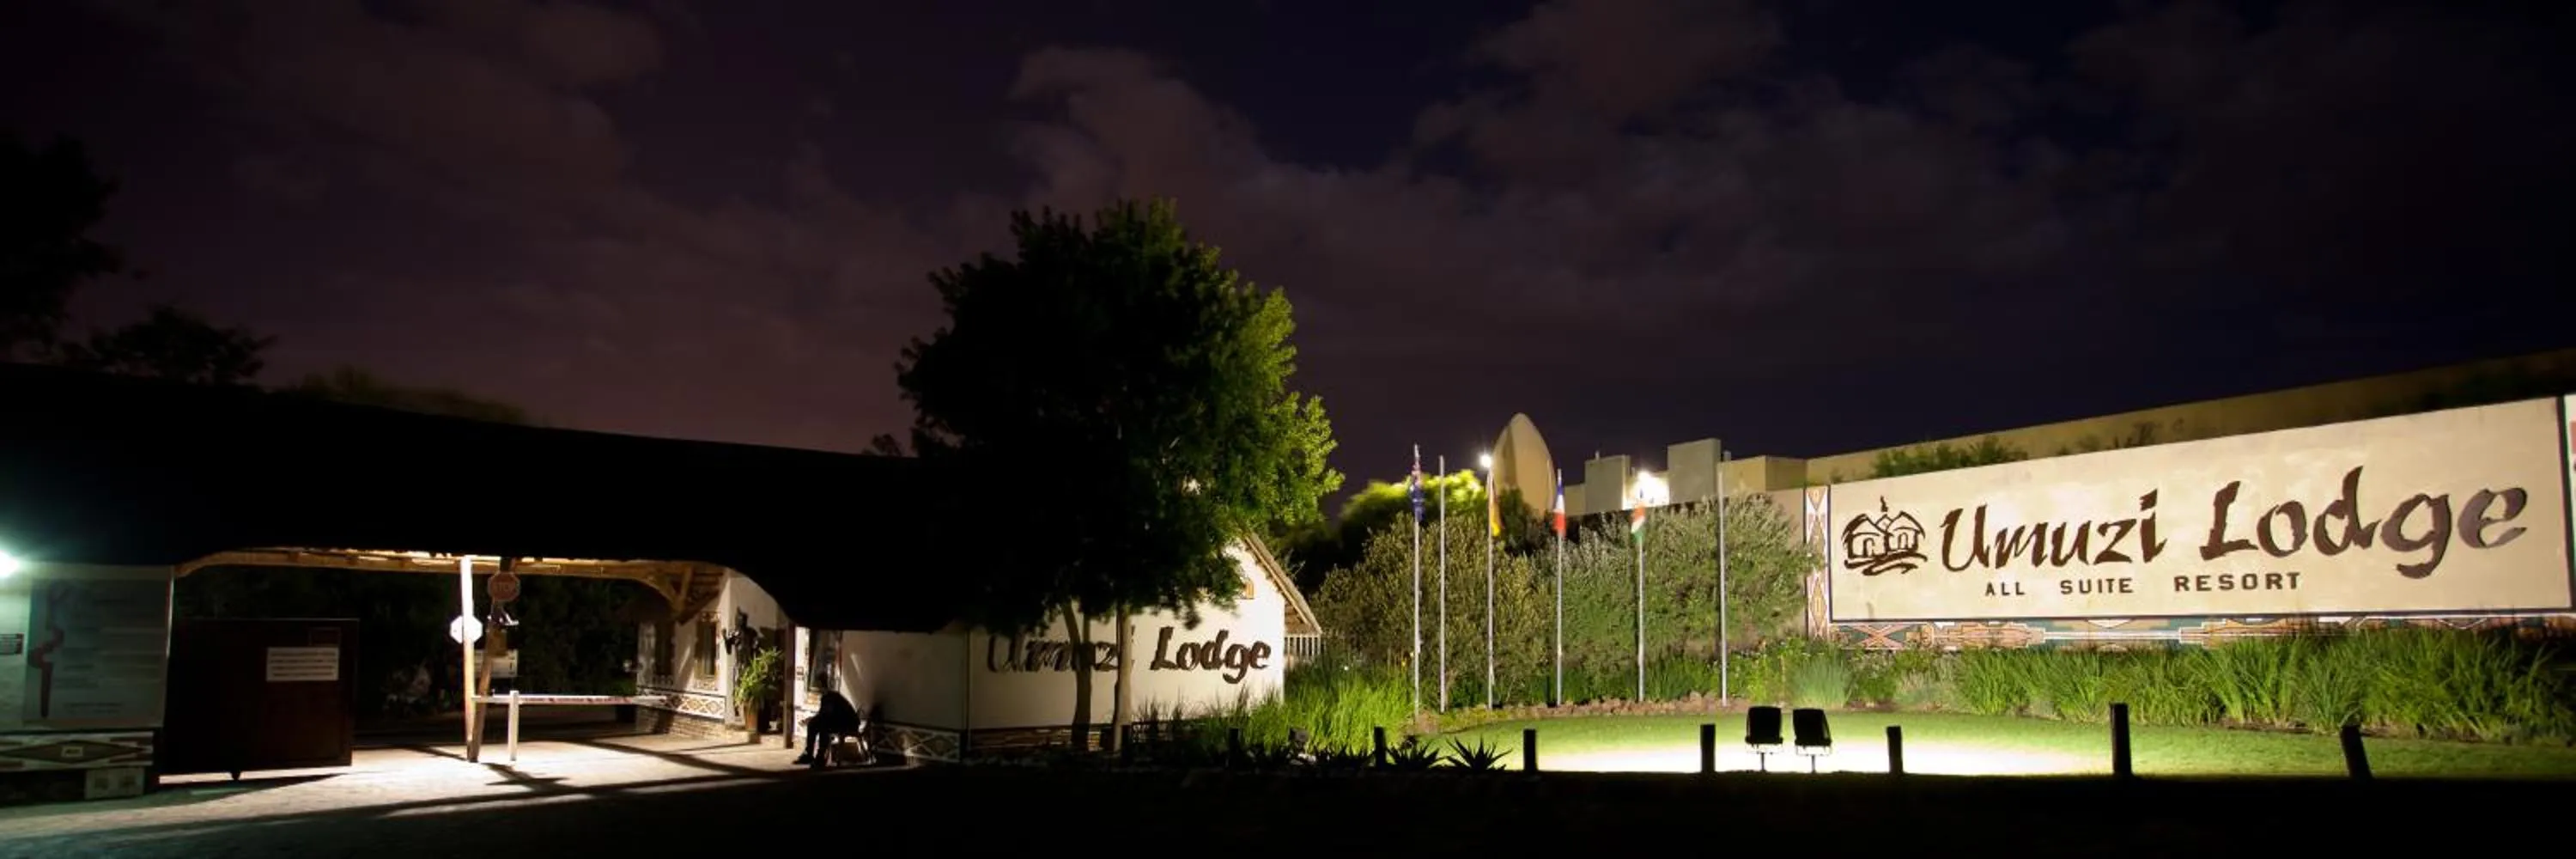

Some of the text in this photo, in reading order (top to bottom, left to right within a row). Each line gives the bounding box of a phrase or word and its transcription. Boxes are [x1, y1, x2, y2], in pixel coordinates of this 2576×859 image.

[1940, 465, 2529, 580] Umuzi Lodge
[1985, 572, 2301, 596] ALL SUITE RESORT
[987, 626, 1271, 684] Umz Lodge
